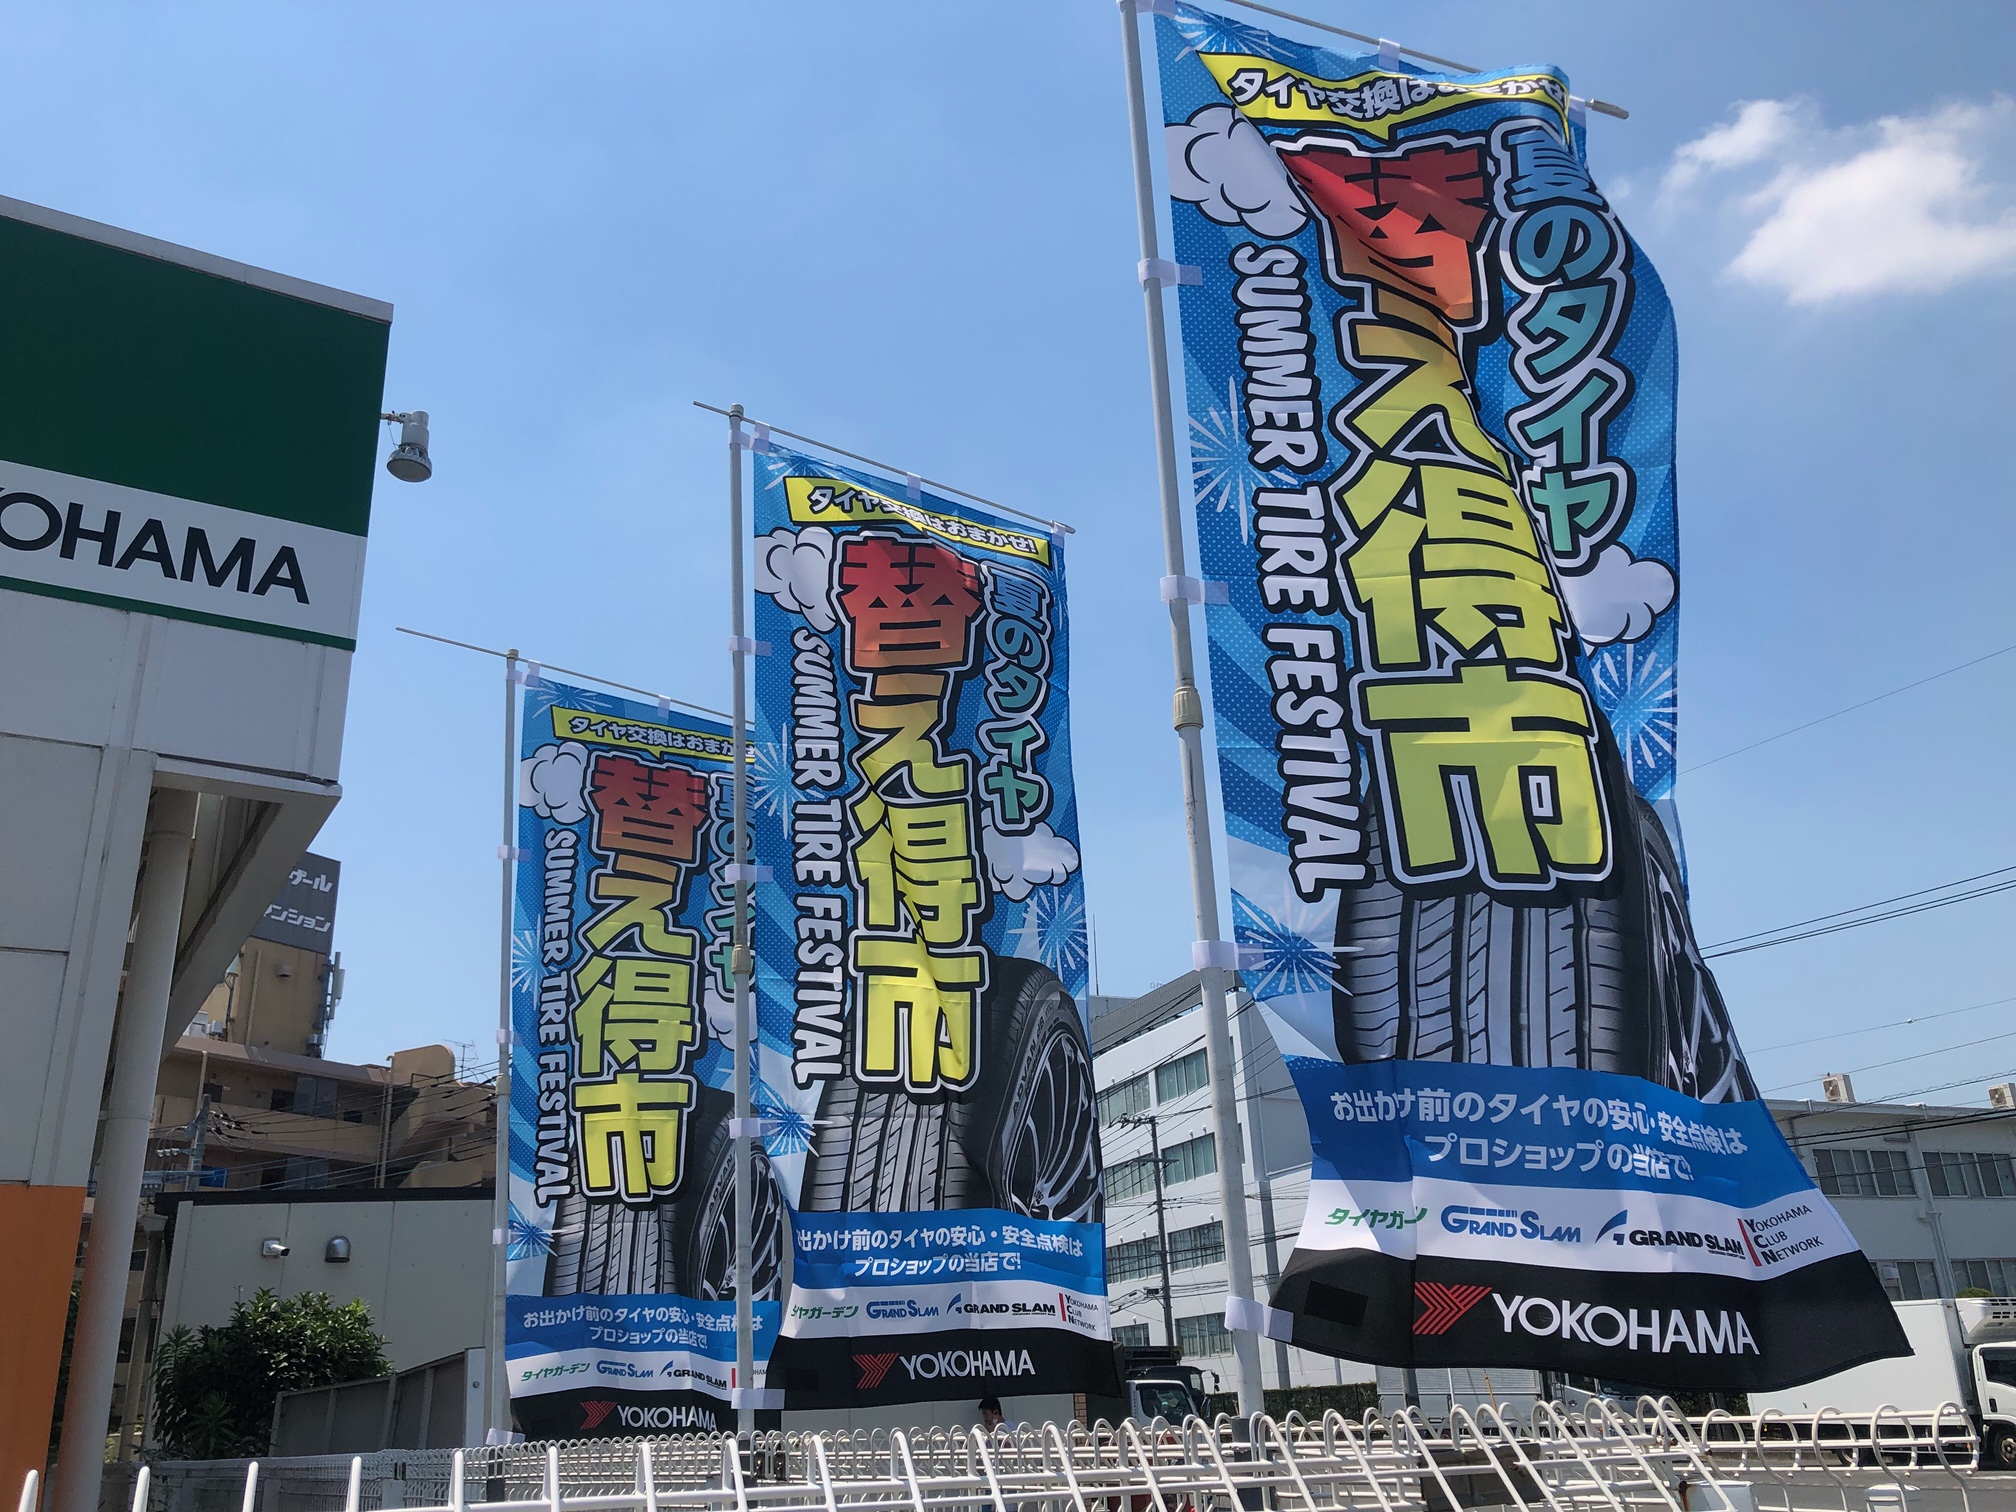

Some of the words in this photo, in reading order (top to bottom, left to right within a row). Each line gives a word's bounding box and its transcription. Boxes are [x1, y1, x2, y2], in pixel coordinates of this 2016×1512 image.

[1233, 244, 1320, 467] SUMMER
[1506, 129, 1613, 553] 夏のタイヤ
[0, 487, 311, 605] OHAMA
[1254, 484, 1331, 609] TIRE
[793, 629, 842, 787] SUMMER
[986, 572, 1046, 820] 夏のタイヤ
[1263, 626, 1367, 894] FESTIVAL
[842, 538, 982, 1082] 替え得市
[794, 799, 842, 883] TIRE
[543, 829, 578, 963] SUMMER
[574, 755, 707, 1194] 替え得市
[795, 896, 845, 1084] FESTIVAL
[539, 973, 569, 1045] TIRE
[536, 1053, 571, 1205] FESTIVAL
[1441, 1204, 1519, 1237] GRAND
[1519, 1210, 1582, 1243] SLAM
[1745, 1204, 1813, 1233] YOKOHAMA
[796, 1225, 1084, 1257] 出かけ前のタイヤの安心・安全点検は
[1628, 1229, 1704, 1249] GRAND
[1704, 1234, 1745, 1256] SLAM
[1754, 1230, 1788, 1249] CLUB
[1761, 1236, 1825, 1266] NETWORK
[854, 1251, 1022, 1278] プロショップの当店で!
[866, 1300, 907, 1320] GRAND
[907, 1299, 940, 1318] SLAM
[963, 1303, 1010, 1315] GRAND
[1011, 1302, 1056, 1315] SLAM
[1064, 1293, 1100, 1312] YOKOHAMA
[1067, 1314, 1097, 1332] NETWORK
[1492, 1292, 1761, 1356] YOKOHAMA
[520, 1362, 591, 1382] タイヤガーデン
[596, 1359, 627, 1378] GRAND
[627, 1362, 654, 1378] SLAM
[673, 1369, 706, 1383] GRAND
[705, 1374, 728, 1389] SLAM
[899, 1349, 1036, 1381] YOKOHAMA
[617, 1404, 718, 1433] YOKOHAMA
